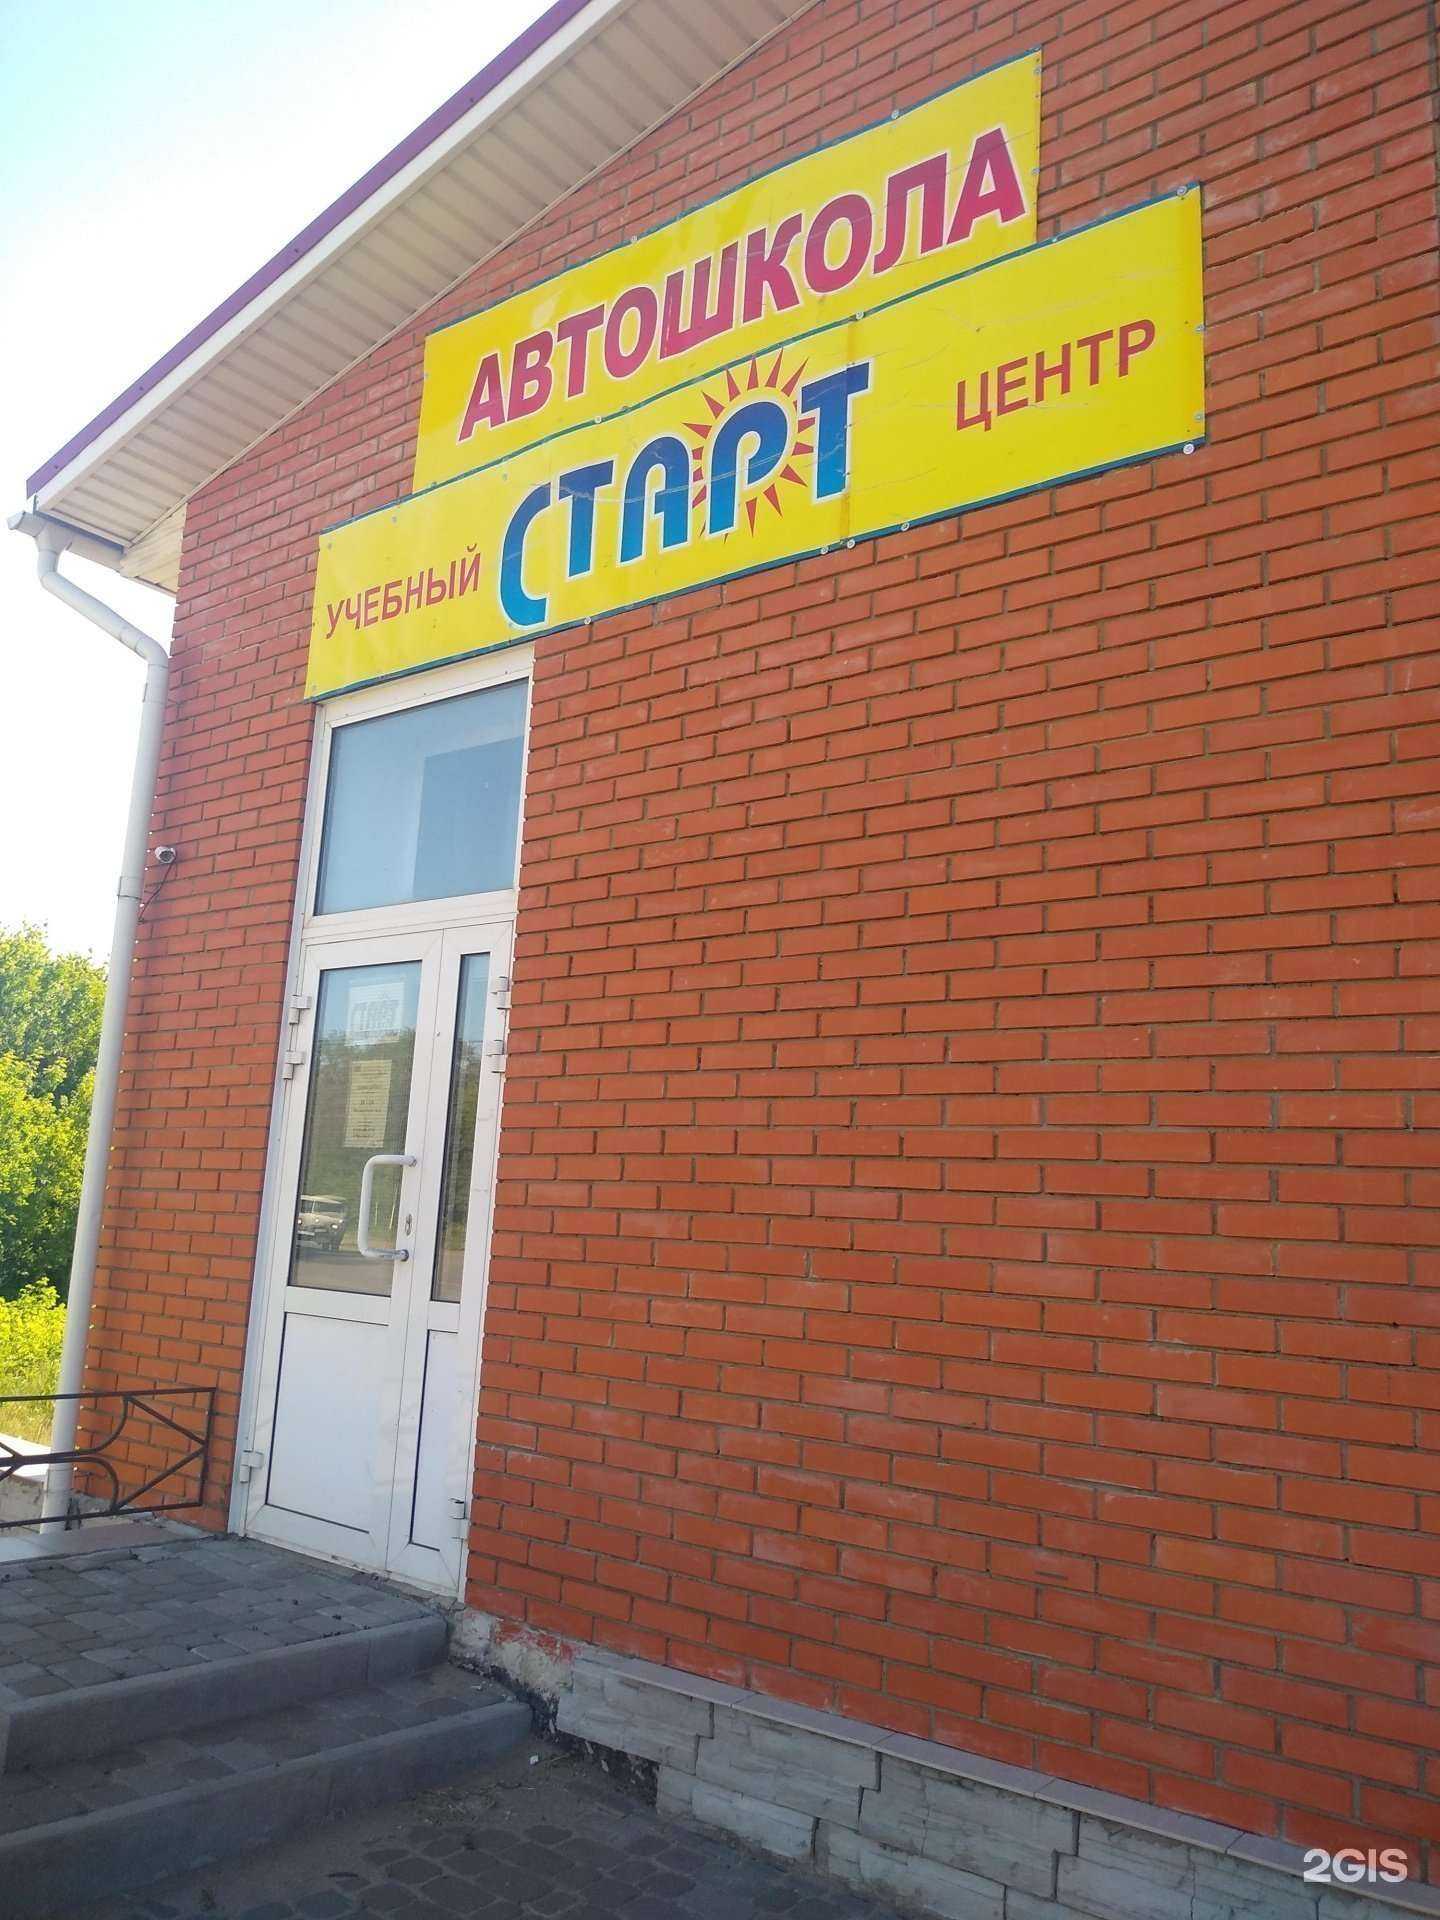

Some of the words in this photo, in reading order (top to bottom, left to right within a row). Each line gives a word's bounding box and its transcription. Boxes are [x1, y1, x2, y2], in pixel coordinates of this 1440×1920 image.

[458, 127, 1026, 442] АВТОШКОЛА
[326, 544, 482, 638] УЧЕБНЫЙ
[500, 360, 872, 628] СТАРТ
[956, 318, 1156, 432] ЦЕНТР
